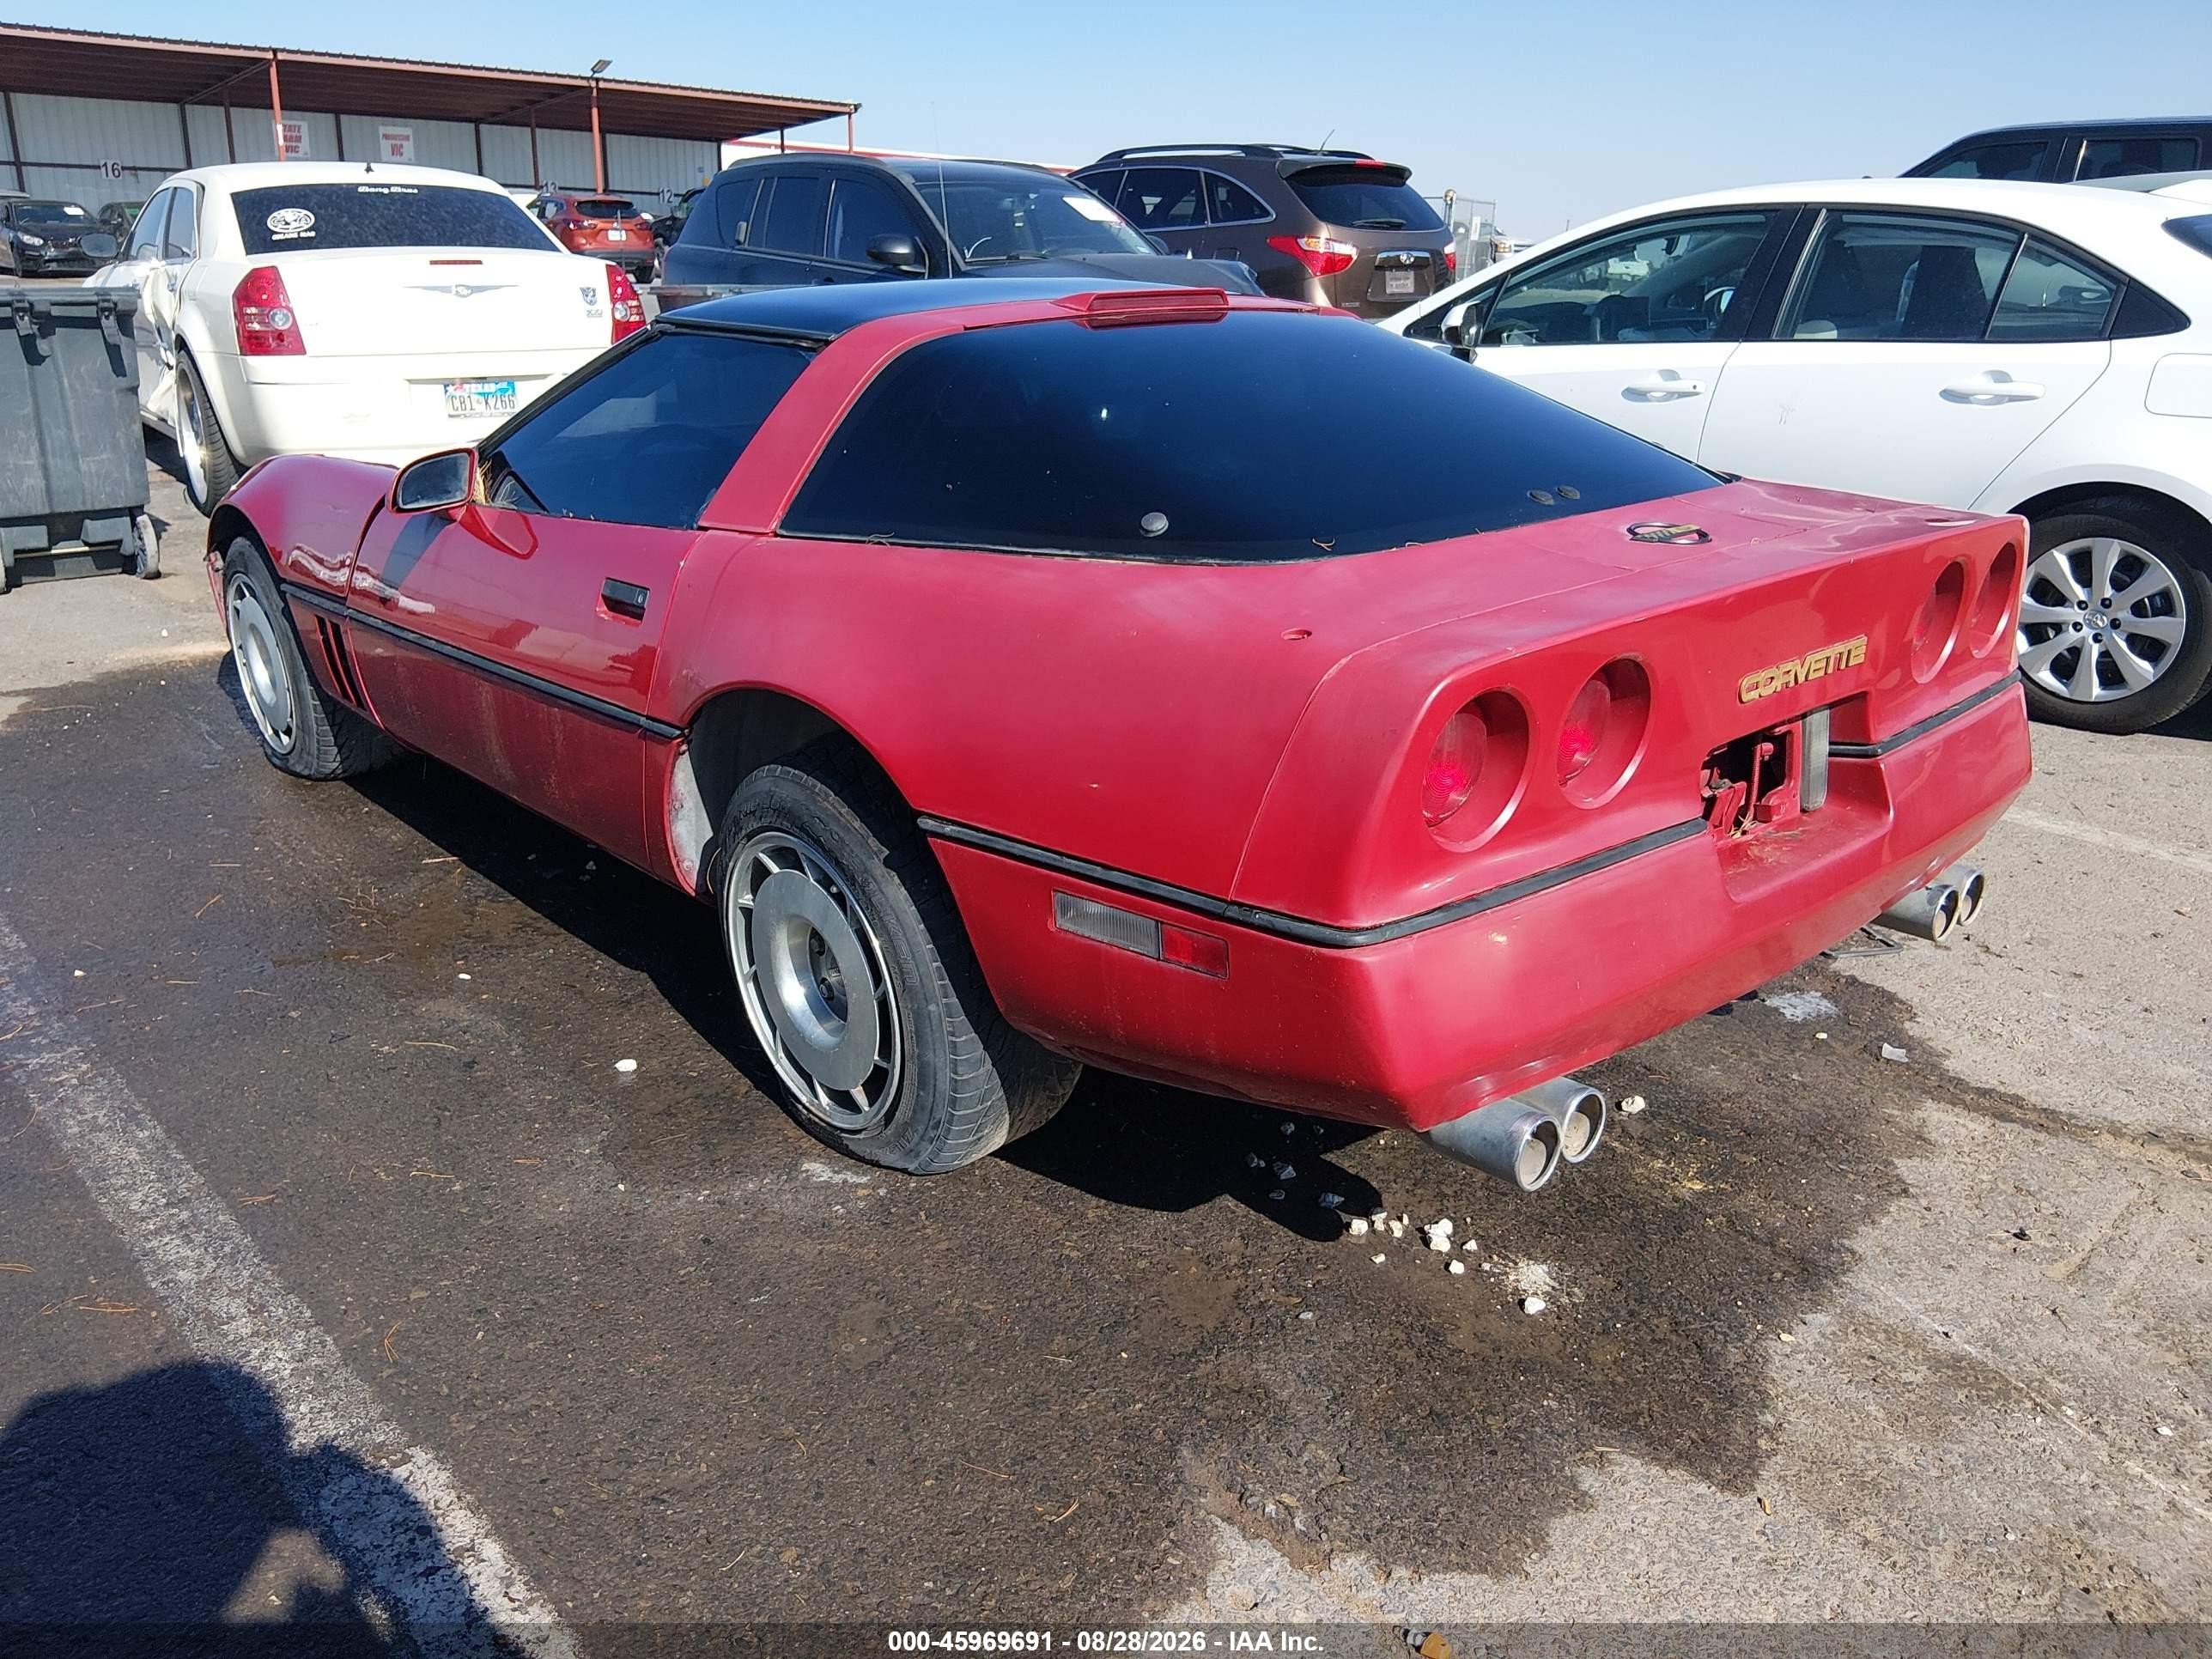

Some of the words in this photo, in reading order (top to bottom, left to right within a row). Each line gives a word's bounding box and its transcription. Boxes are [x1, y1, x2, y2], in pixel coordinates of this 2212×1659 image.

[282, 124, 302, 133] TATE
[283, 134, 302, 143] ARM
[285, 144, 300, 153] VIC
[392, 143, 404, 156] VIC
[102, 161, 121, 179] 16
[659, 188, 674, 204] 12
[483, 394, 515, 410] K266
[1740, 635, 1868, 703] CORVETTE
